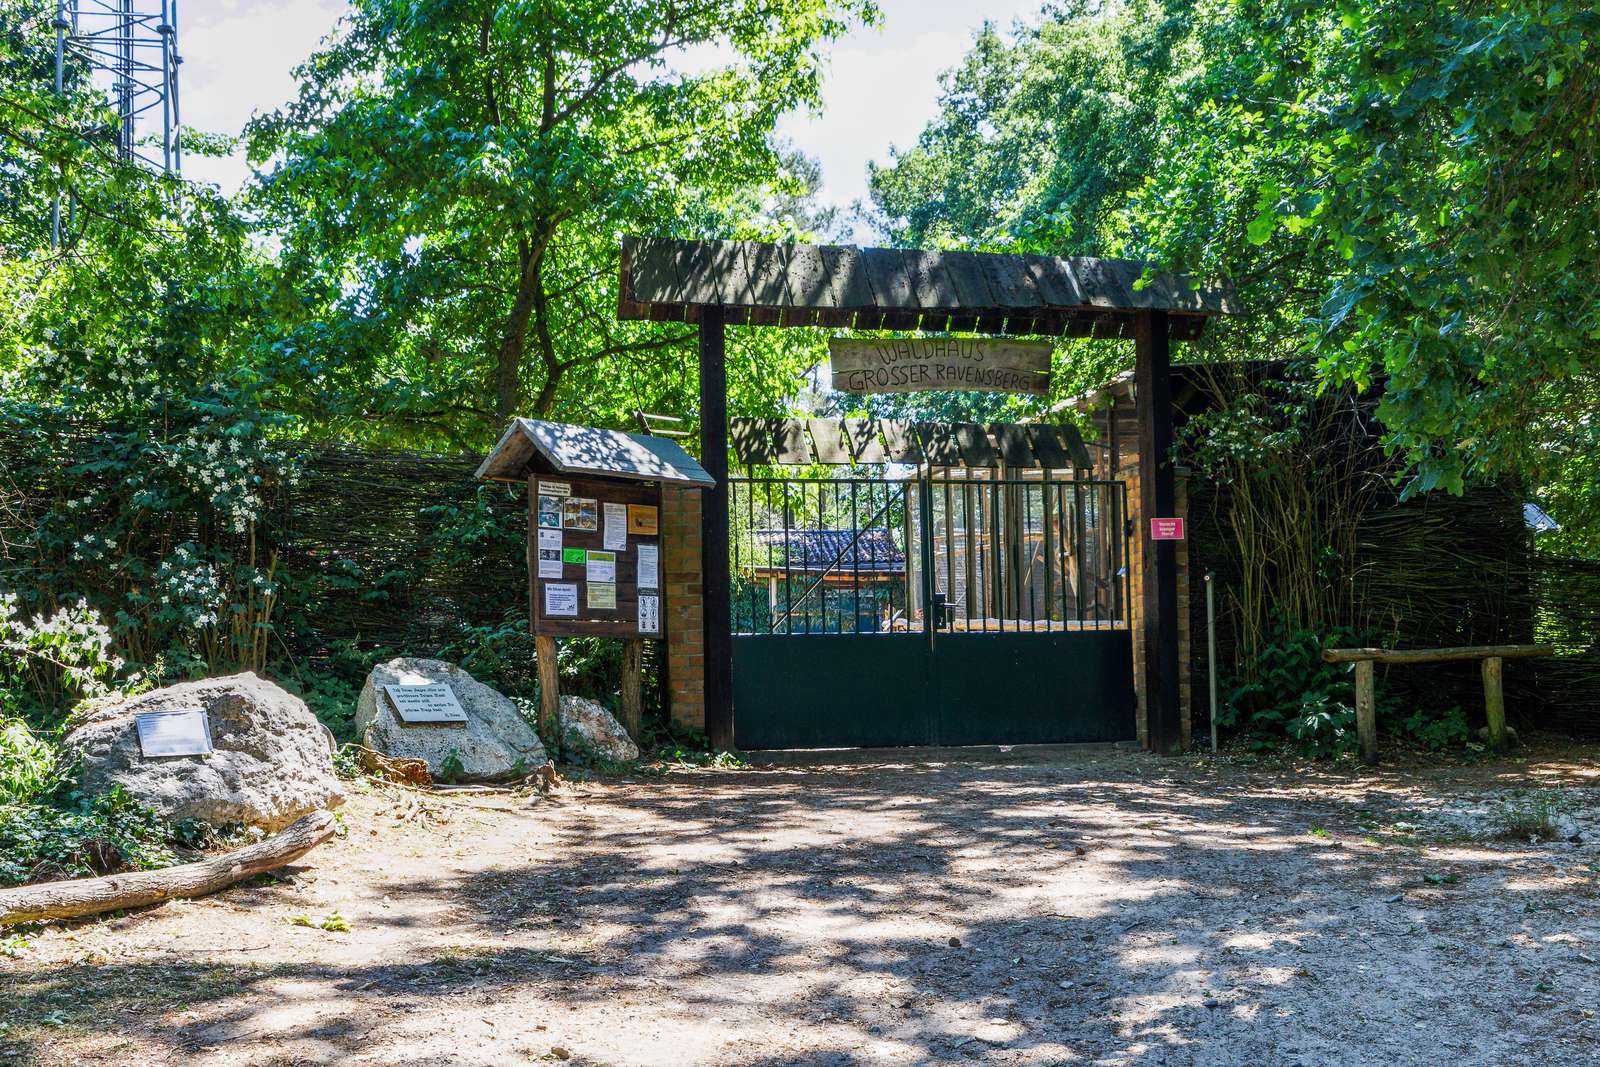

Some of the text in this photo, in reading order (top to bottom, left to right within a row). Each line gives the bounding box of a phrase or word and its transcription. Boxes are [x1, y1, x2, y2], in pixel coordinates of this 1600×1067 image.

[876, 340, 986, 365] WALDHAUS
[849, 364, 1030, 391] GROSSER RAVENSBERG
